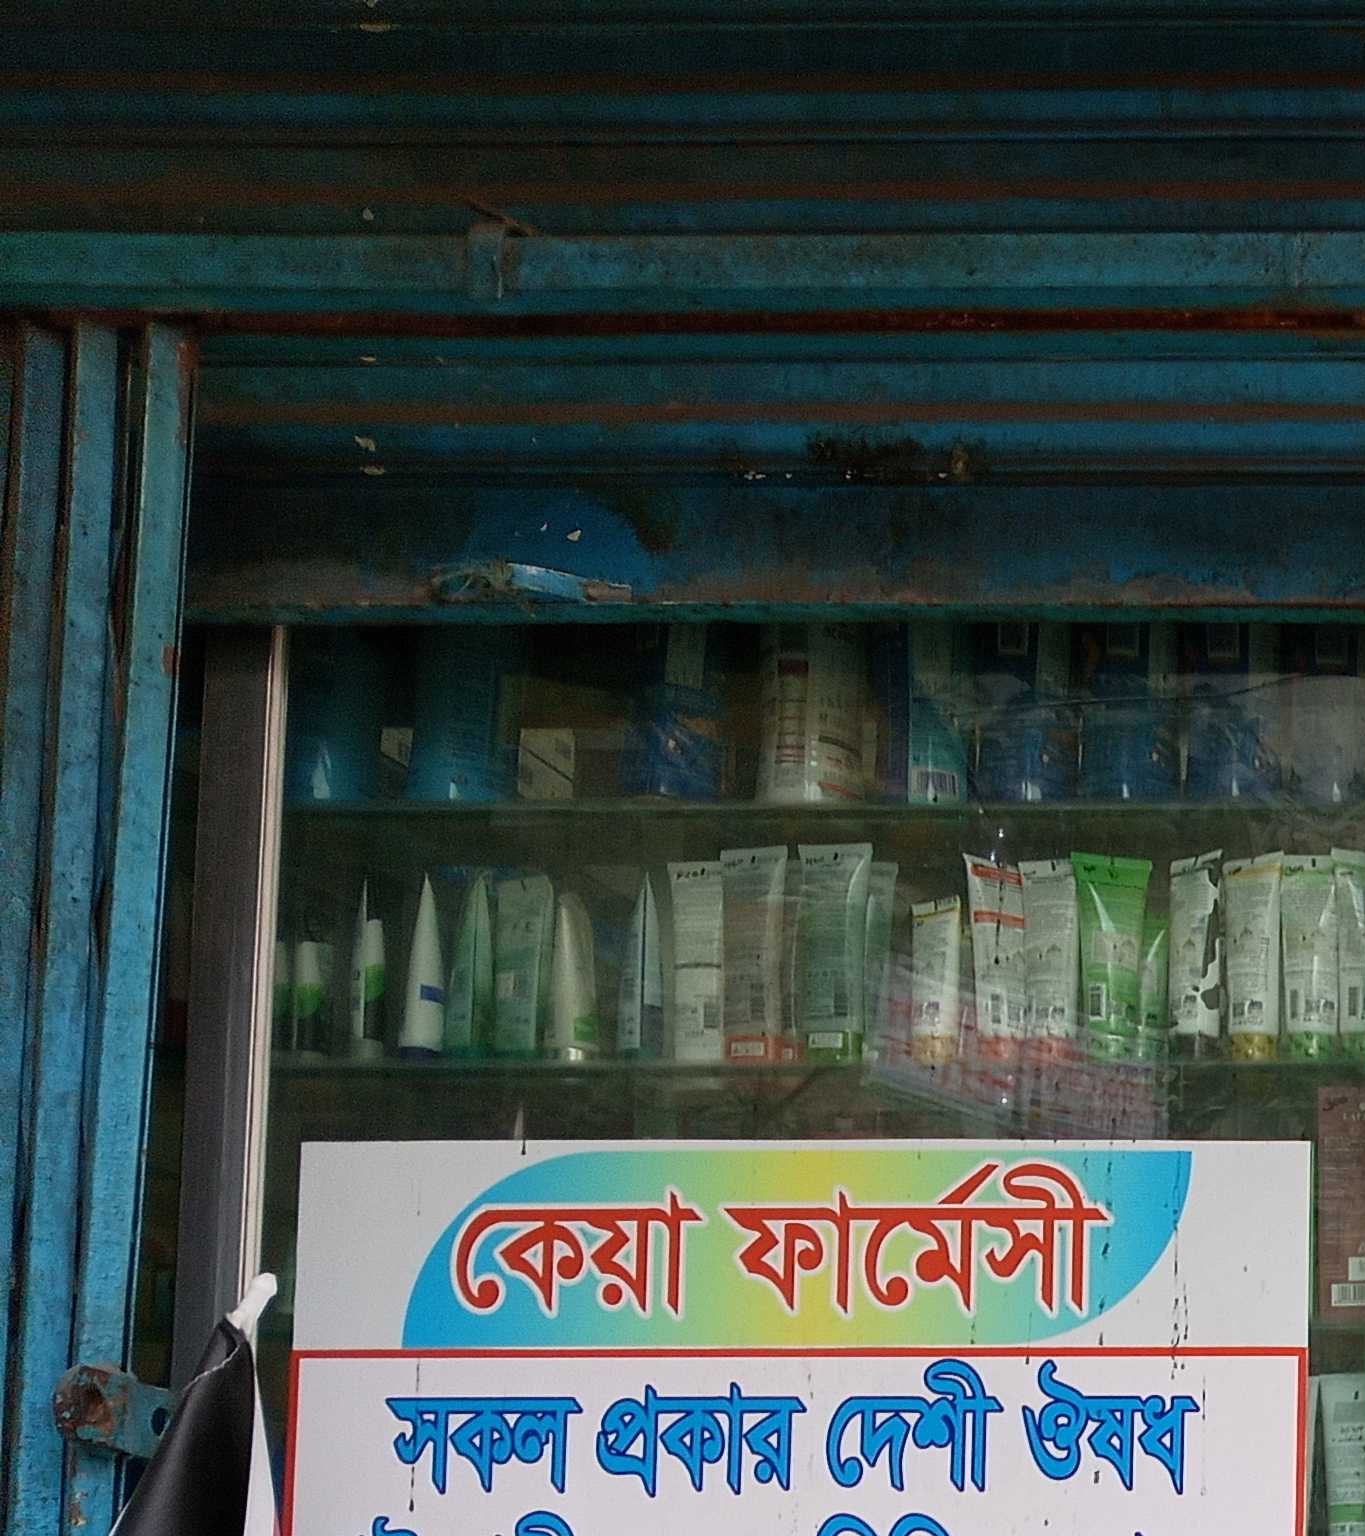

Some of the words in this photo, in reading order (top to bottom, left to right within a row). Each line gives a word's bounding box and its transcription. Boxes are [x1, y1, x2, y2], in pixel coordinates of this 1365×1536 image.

[455, 1190, 701, 1315] কেয়া
[725, 1163, 1110, 1315] ফার্মেসী
[387, 1393, 582, 1495] সকল
[597, 1383, 805, 1497] প্রকার
[825, 1357, 1003, 1491] দেশী
[1023, 1358, 1199, 1495] ঔষধ
